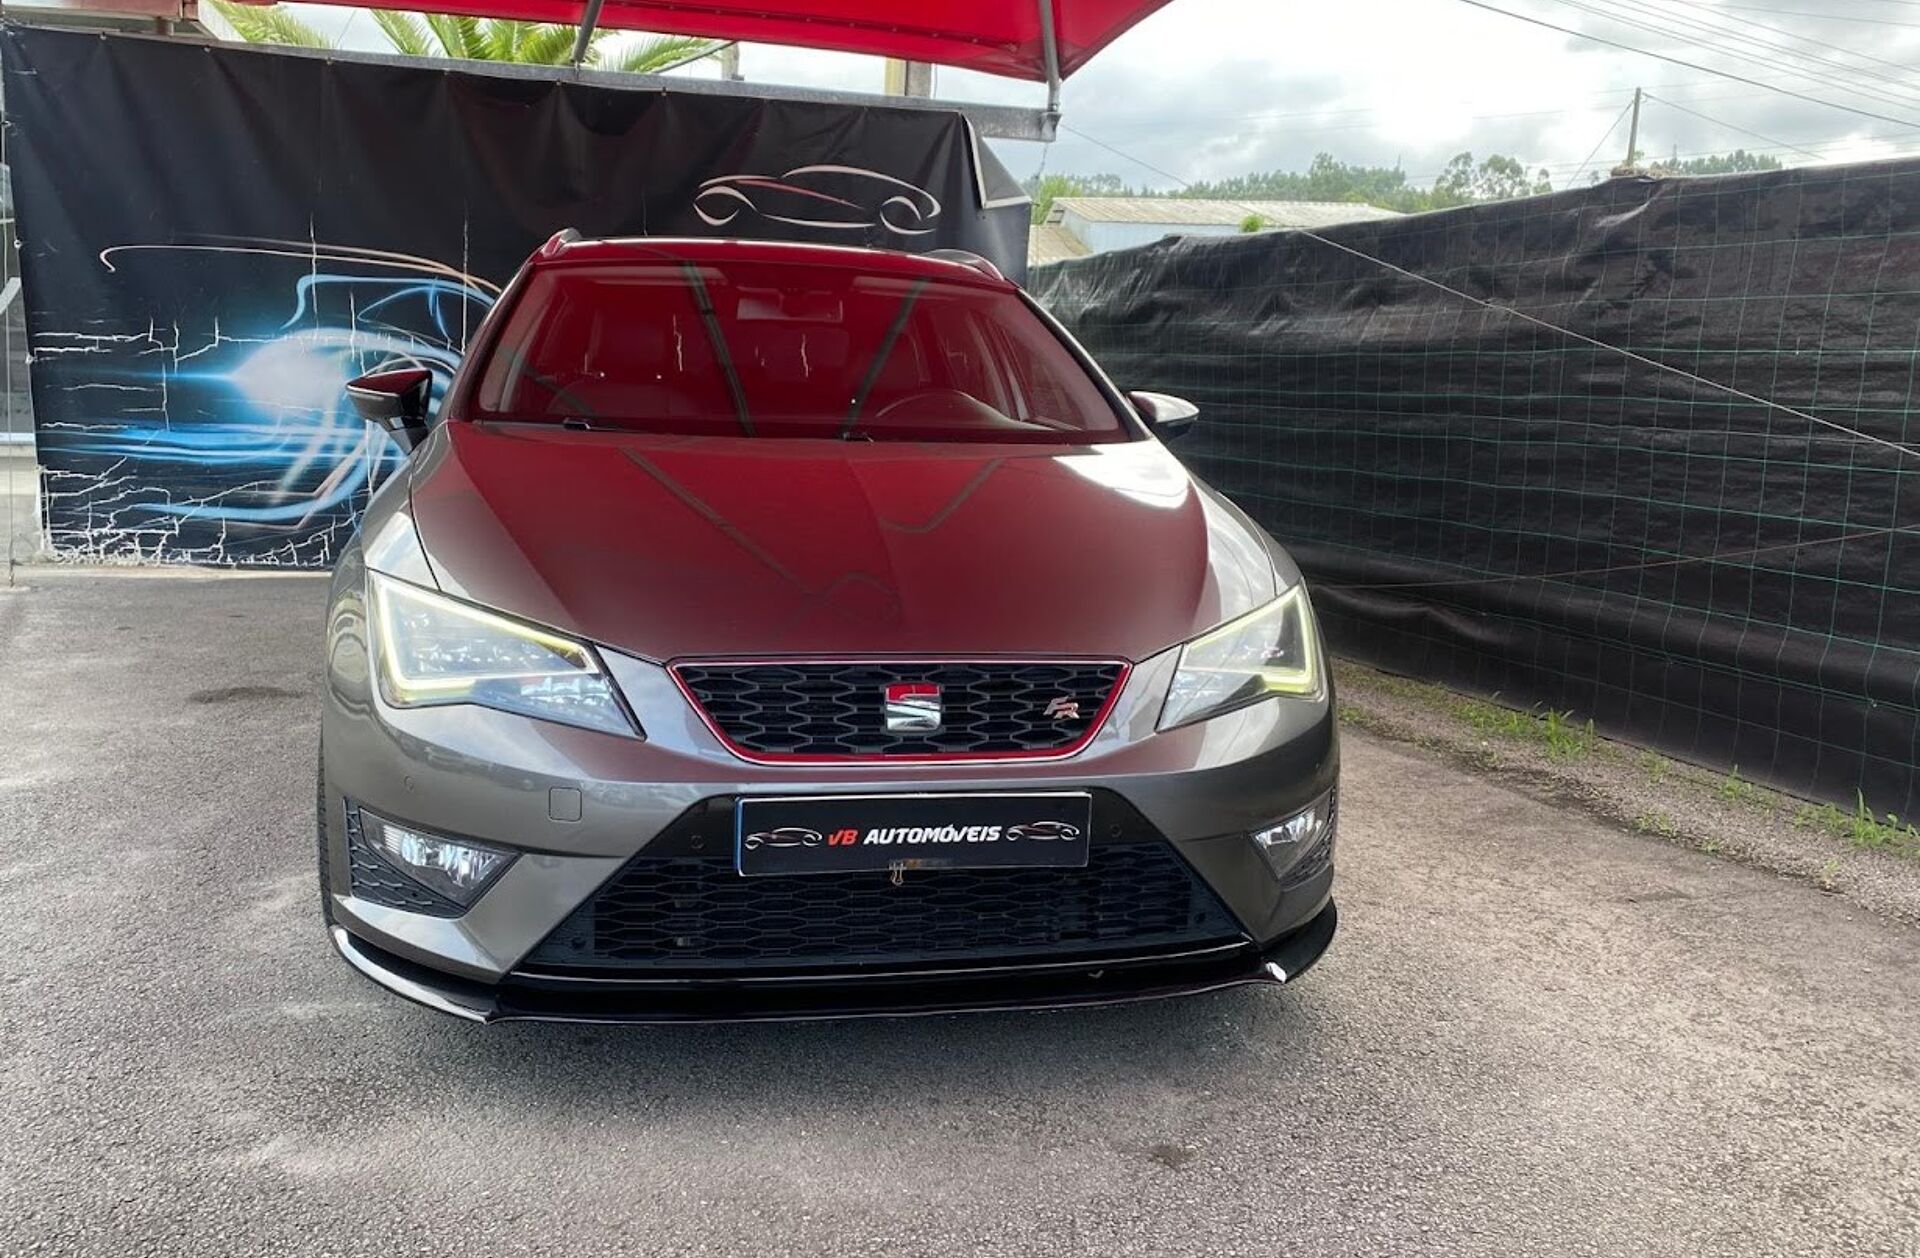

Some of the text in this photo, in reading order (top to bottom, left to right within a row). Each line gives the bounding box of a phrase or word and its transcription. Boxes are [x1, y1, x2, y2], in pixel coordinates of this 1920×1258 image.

[1044, 695, 1080, 719] FR
[828, 824, 1002, 846] VB AUTOMÓVEIS
